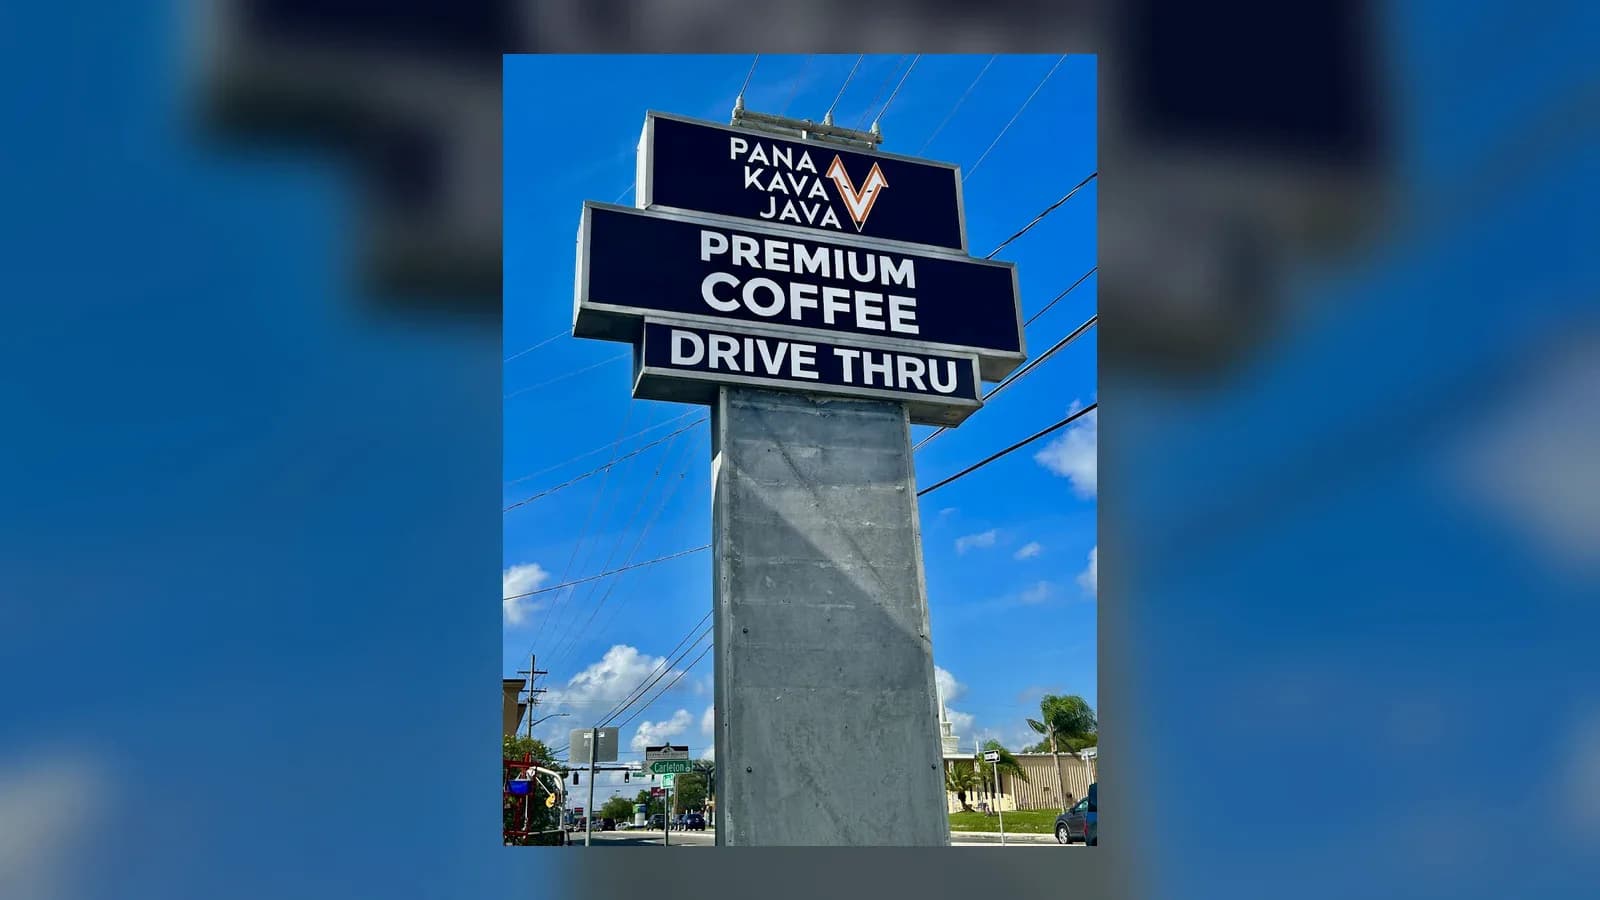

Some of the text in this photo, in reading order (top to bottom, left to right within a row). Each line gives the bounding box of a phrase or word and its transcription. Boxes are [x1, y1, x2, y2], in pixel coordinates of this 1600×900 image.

[731, 137, 817, 173] PANA
[745, 166, 829, 200] KAVA
[760, 197, 841, 229] JAVA
[701, 230, 915, 288] PREMIUM
[702, 272, 919, 334] COFFEE
[671, 330, 957, 393] DRIVE THRU
[654, 762, 685, 773] Carleton
